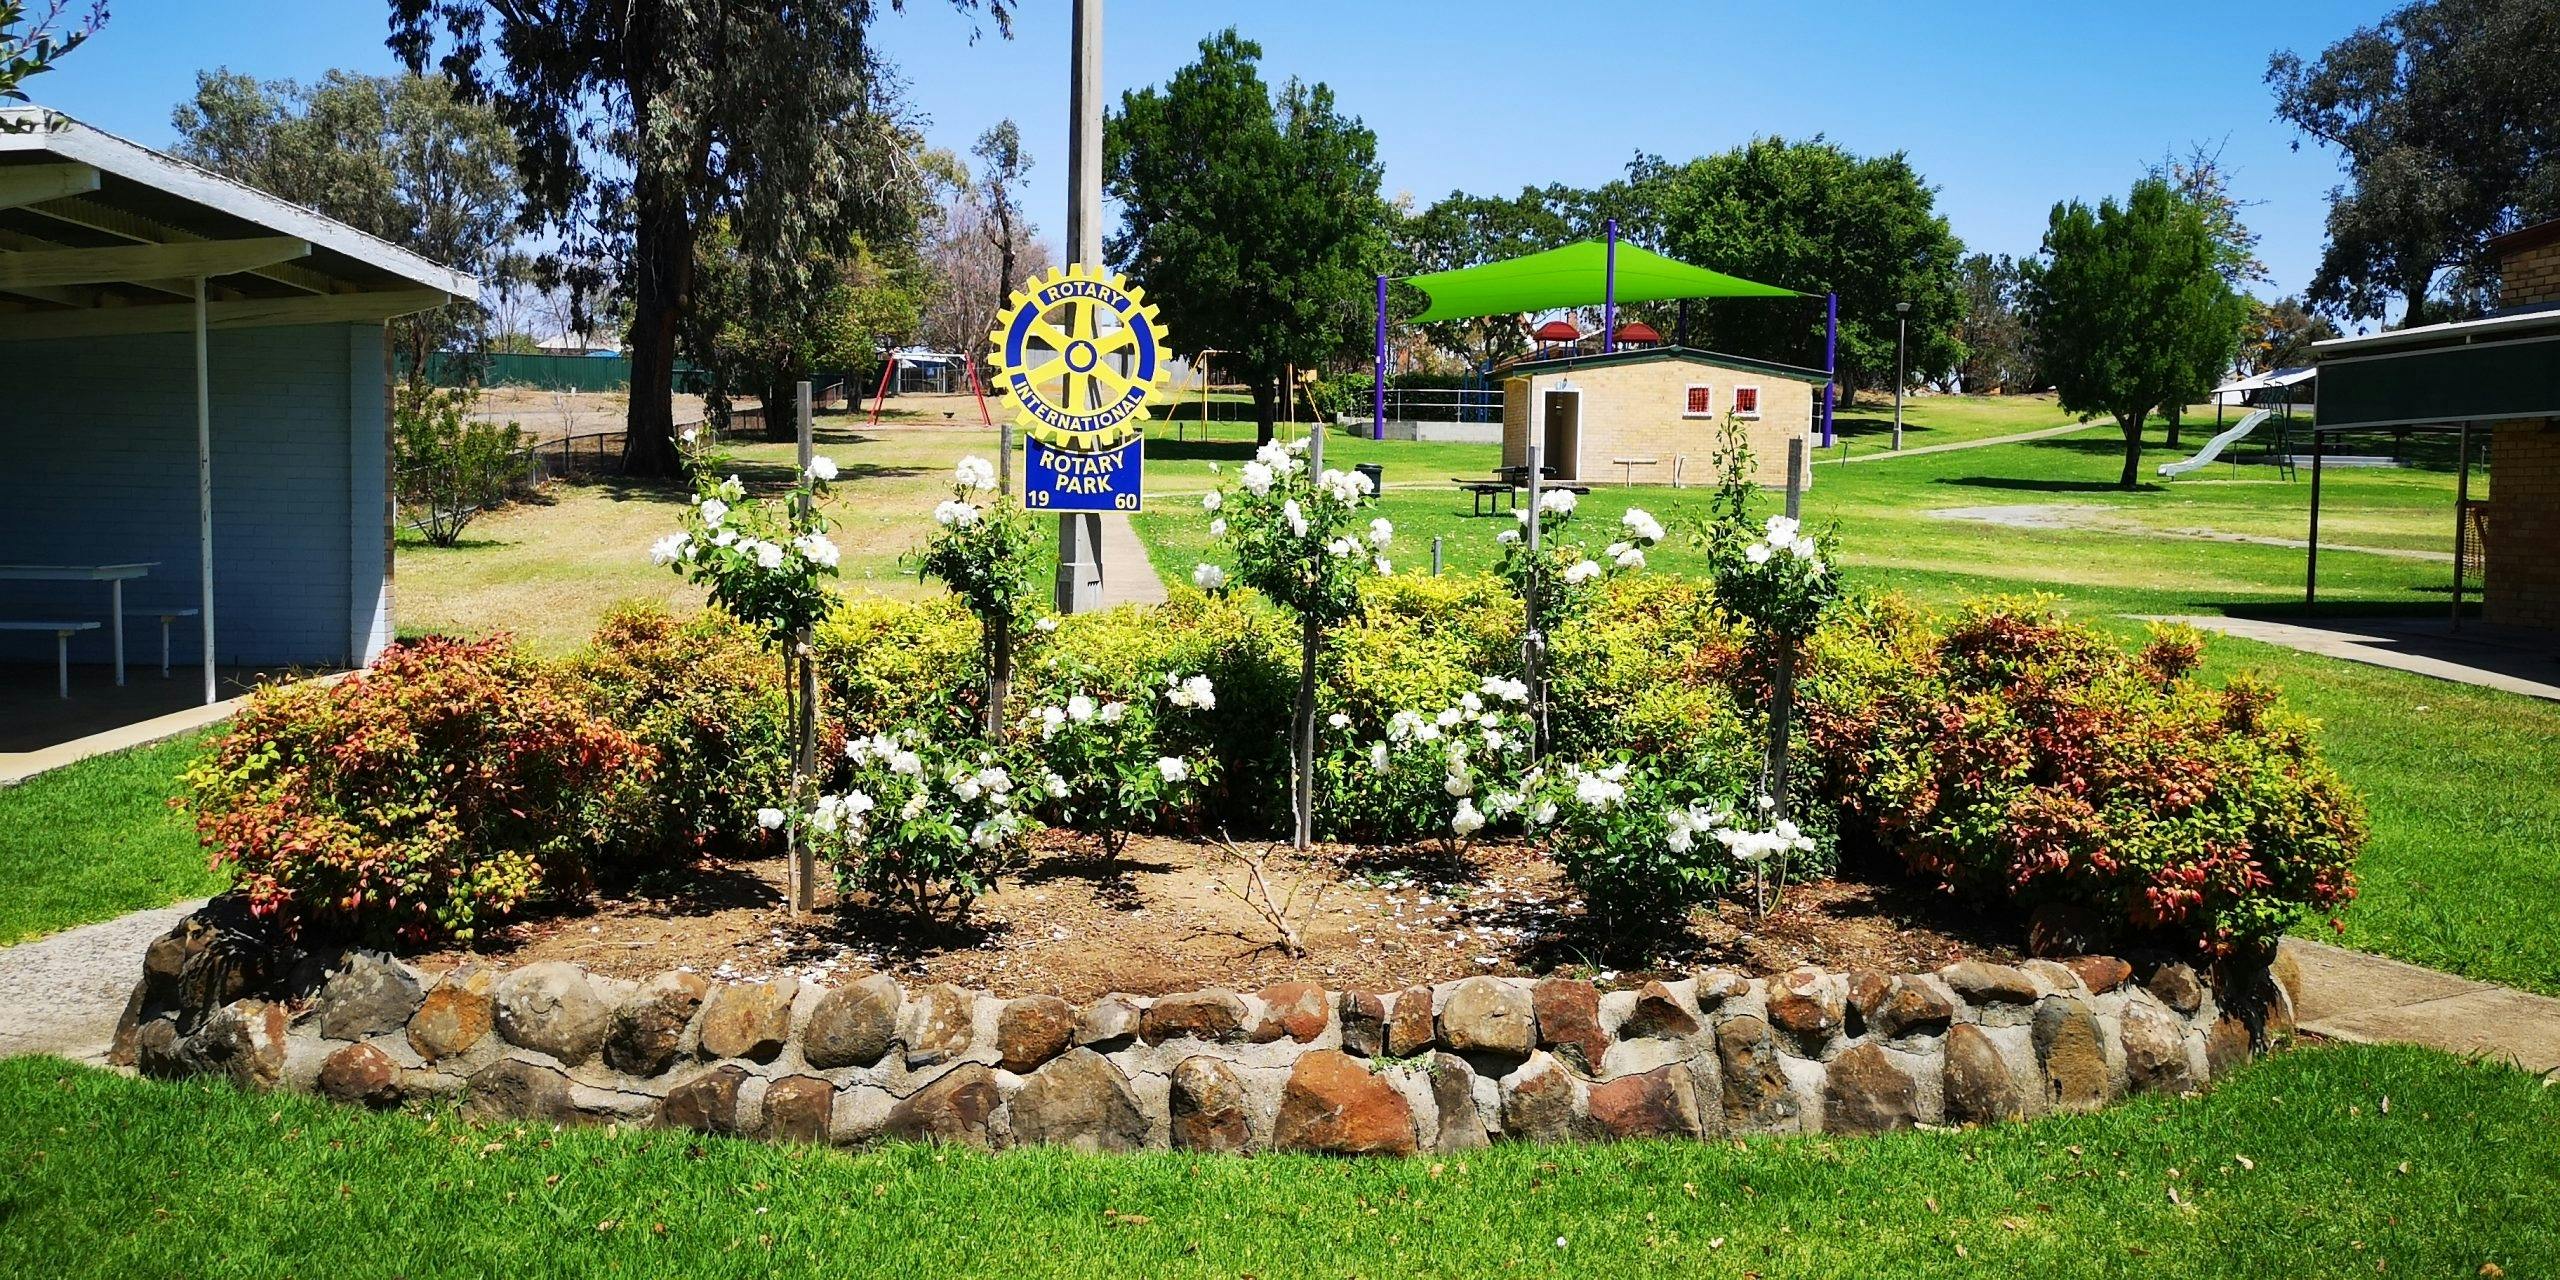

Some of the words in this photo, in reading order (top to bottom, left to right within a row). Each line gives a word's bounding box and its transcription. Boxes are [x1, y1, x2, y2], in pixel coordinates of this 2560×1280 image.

[1048, 281, 1125, 305] ROTARY
[1015, 382, 1142, 431] INTERNATIONAL
[1039, 451, 1125, 475] ROTARY
[1055, 475, 1114, 494] PARK
[1028, 490, 1049, 507] 19
[1115, 493, 1137, 509] 60
